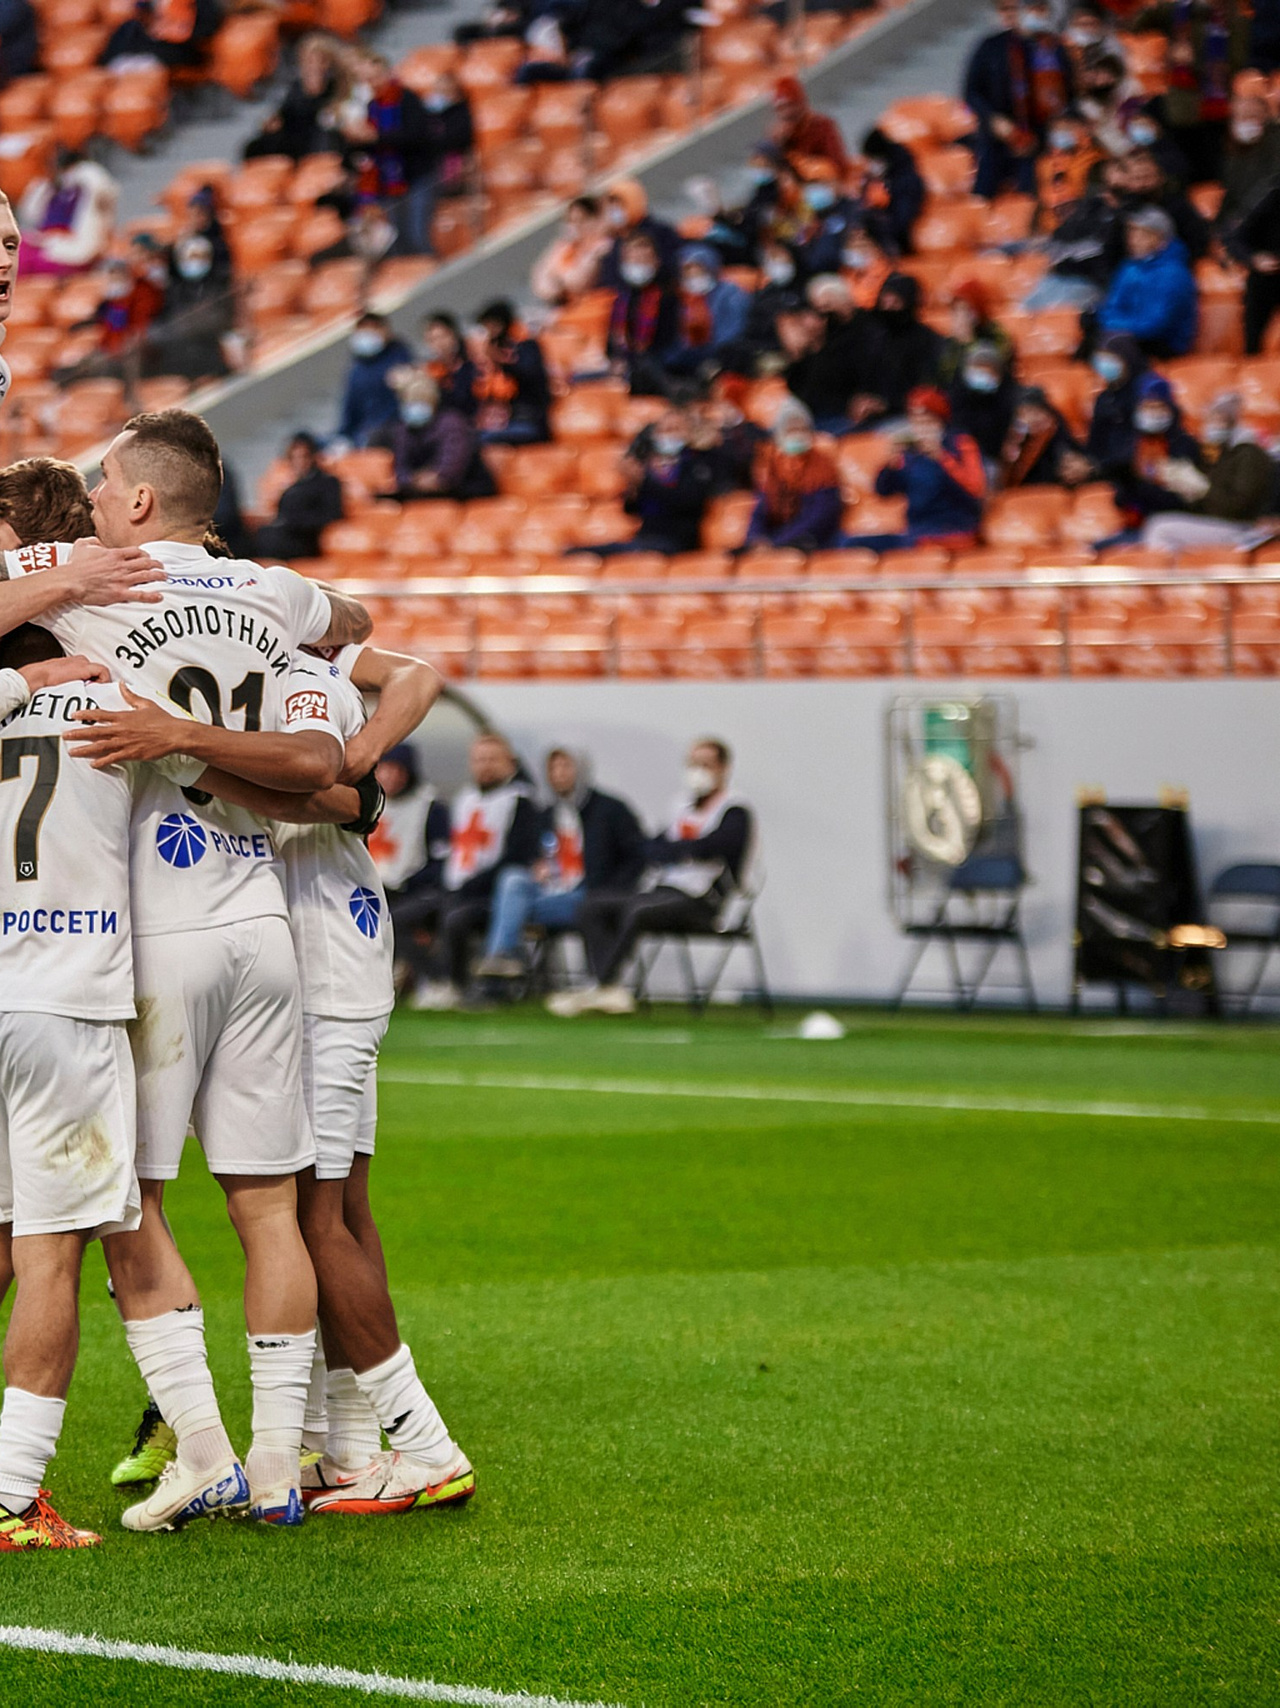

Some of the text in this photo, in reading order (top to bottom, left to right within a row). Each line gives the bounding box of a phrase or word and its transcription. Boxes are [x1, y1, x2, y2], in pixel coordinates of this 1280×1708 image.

[115, 605, 291, 678] ЗАБОЛОТНЫЙ
[288, 691, 327, 716] FON
[0, 735, 61, 883] 7
[2, 908, 118, 936] РОССЕТИ
